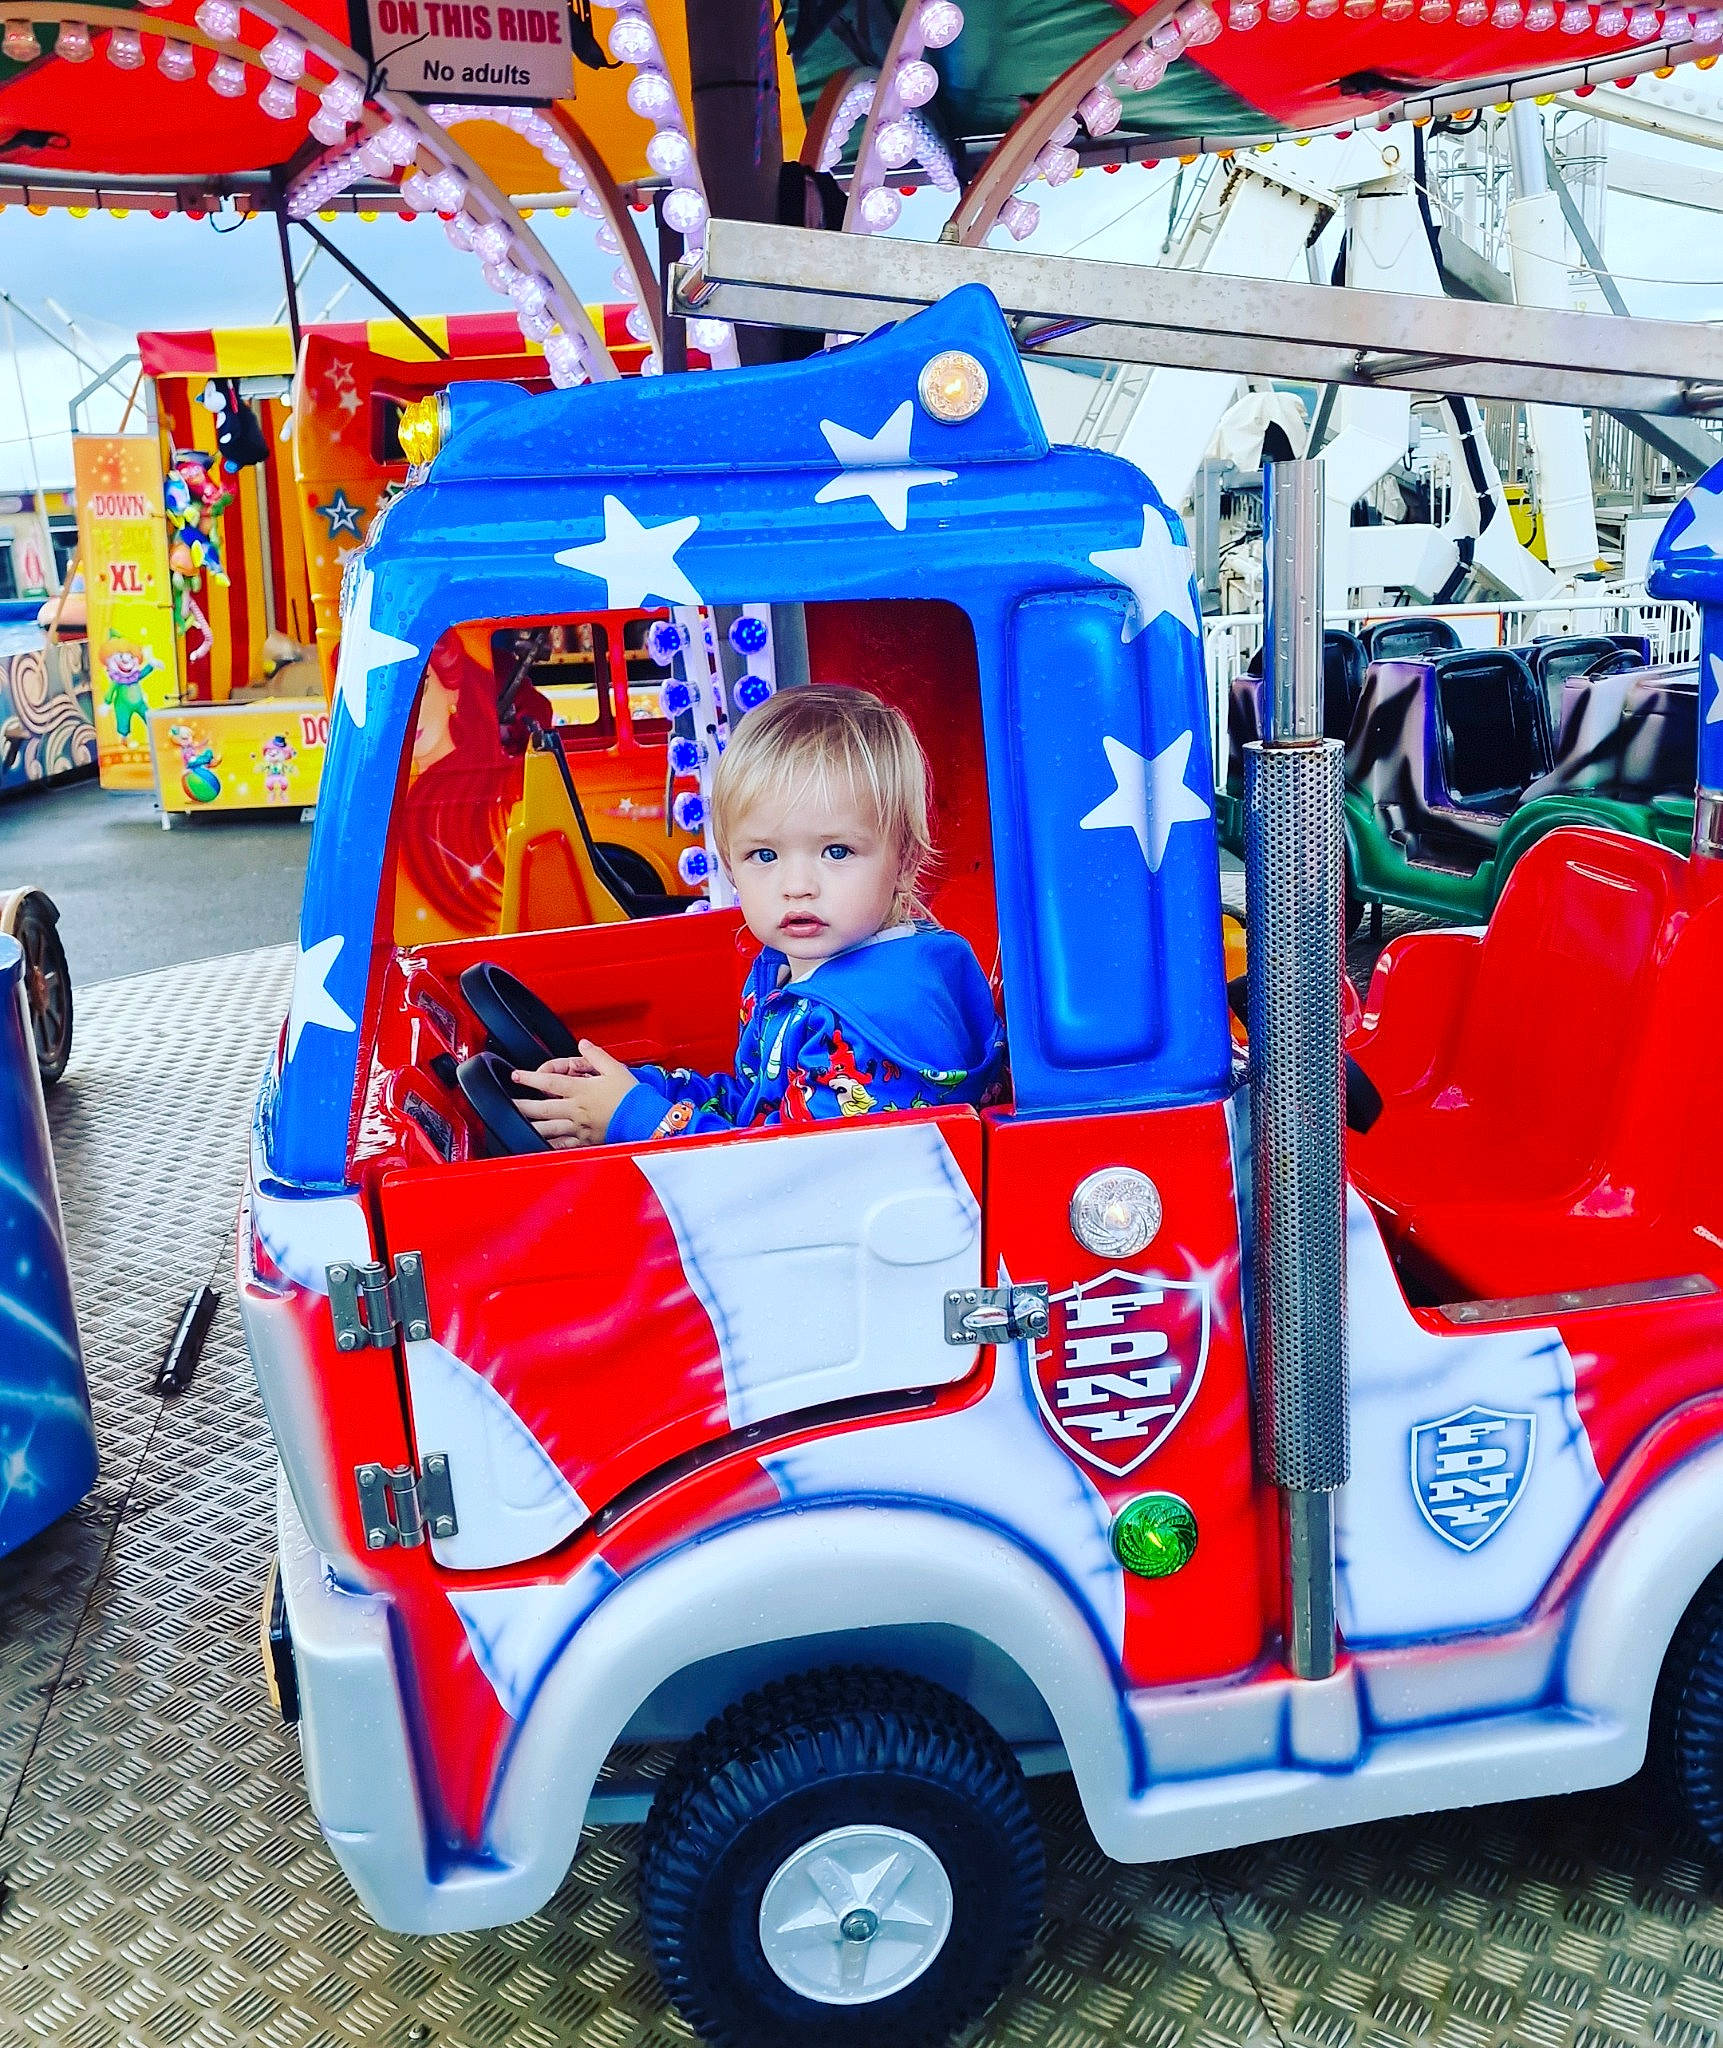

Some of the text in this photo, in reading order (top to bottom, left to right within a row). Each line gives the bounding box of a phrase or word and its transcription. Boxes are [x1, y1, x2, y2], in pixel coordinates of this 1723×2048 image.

[378, 0, 562, 45] ON THIS RIDE
[423, 59, 531, 86] No adults
[95, 495, 145, 516] DOWN
[110, 564, 143, 592] XL
[1055, 1291, 1182, 1442] FDNY
[1428, 1420, 1514, 1528] FDNY
